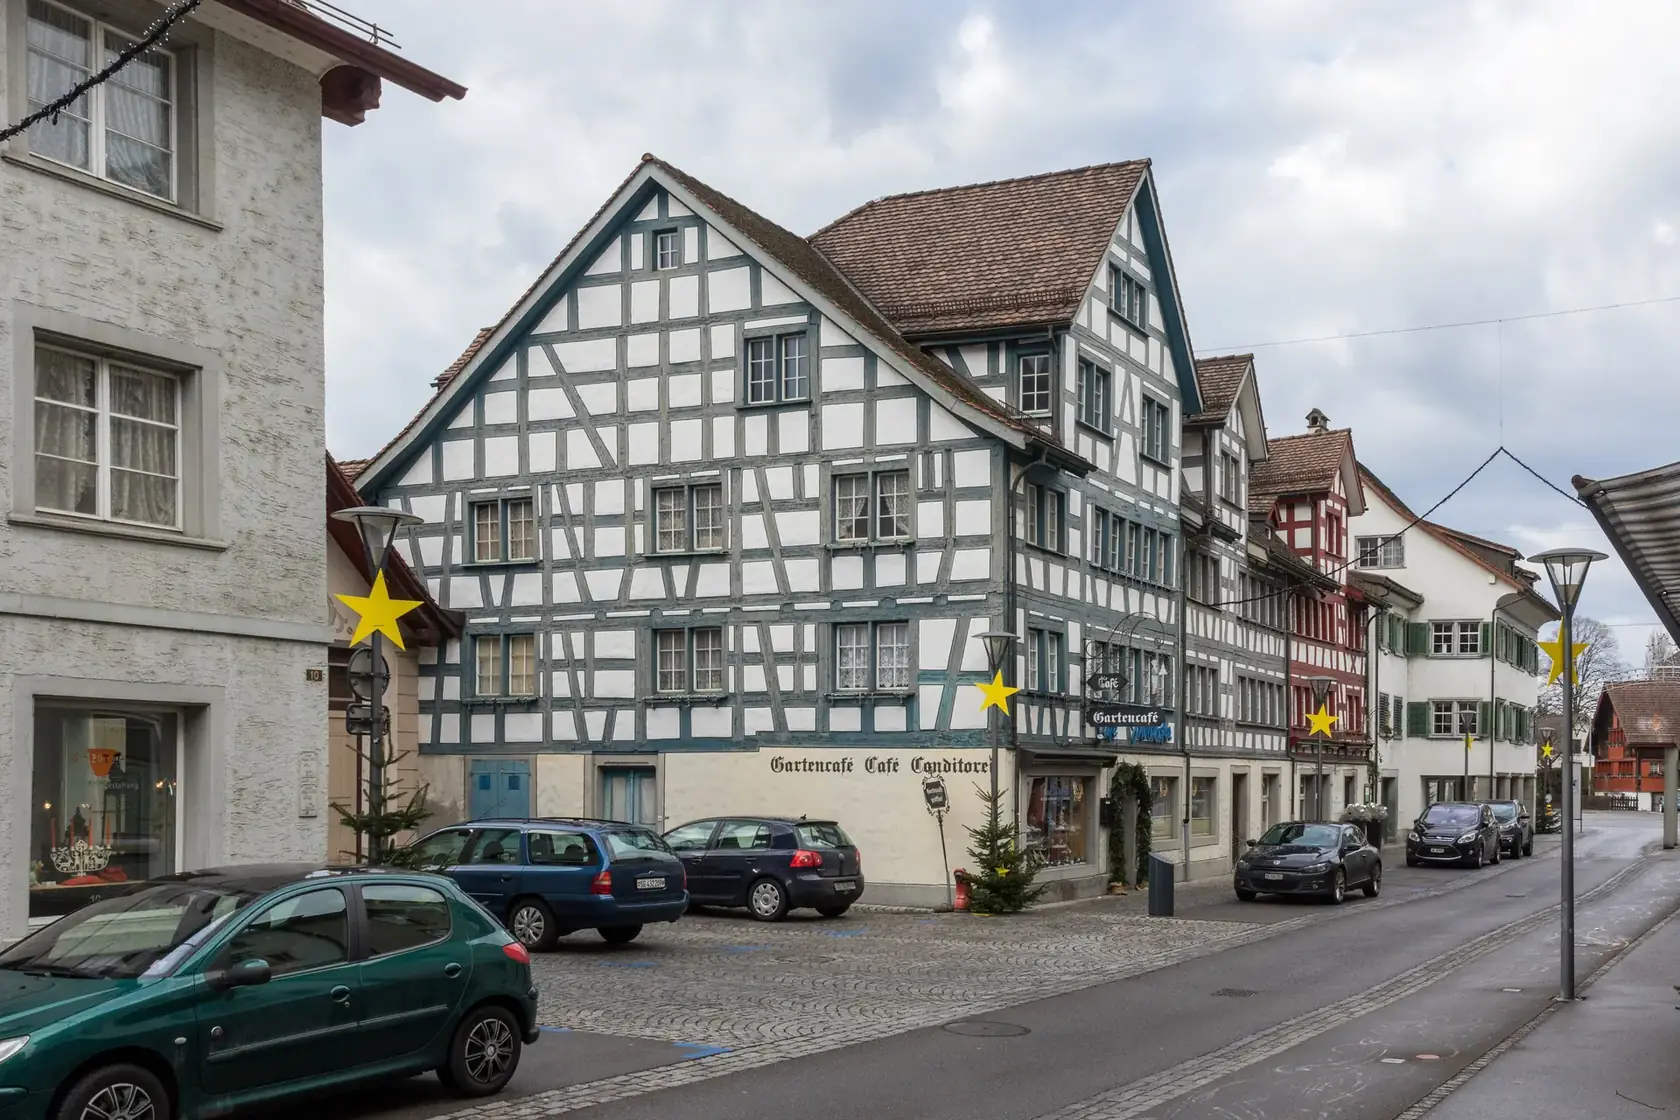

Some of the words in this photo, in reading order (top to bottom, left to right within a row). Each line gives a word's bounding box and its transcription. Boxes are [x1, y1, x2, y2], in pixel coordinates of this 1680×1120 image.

[310, 670, 319, 680] 10
[1098, 676, 1119, 691] Café
[1093, 711, 1159, 725] Gartencafé
[770, 756, 854, 776] Gartencafé
[864, 756, 900, 776] Café
